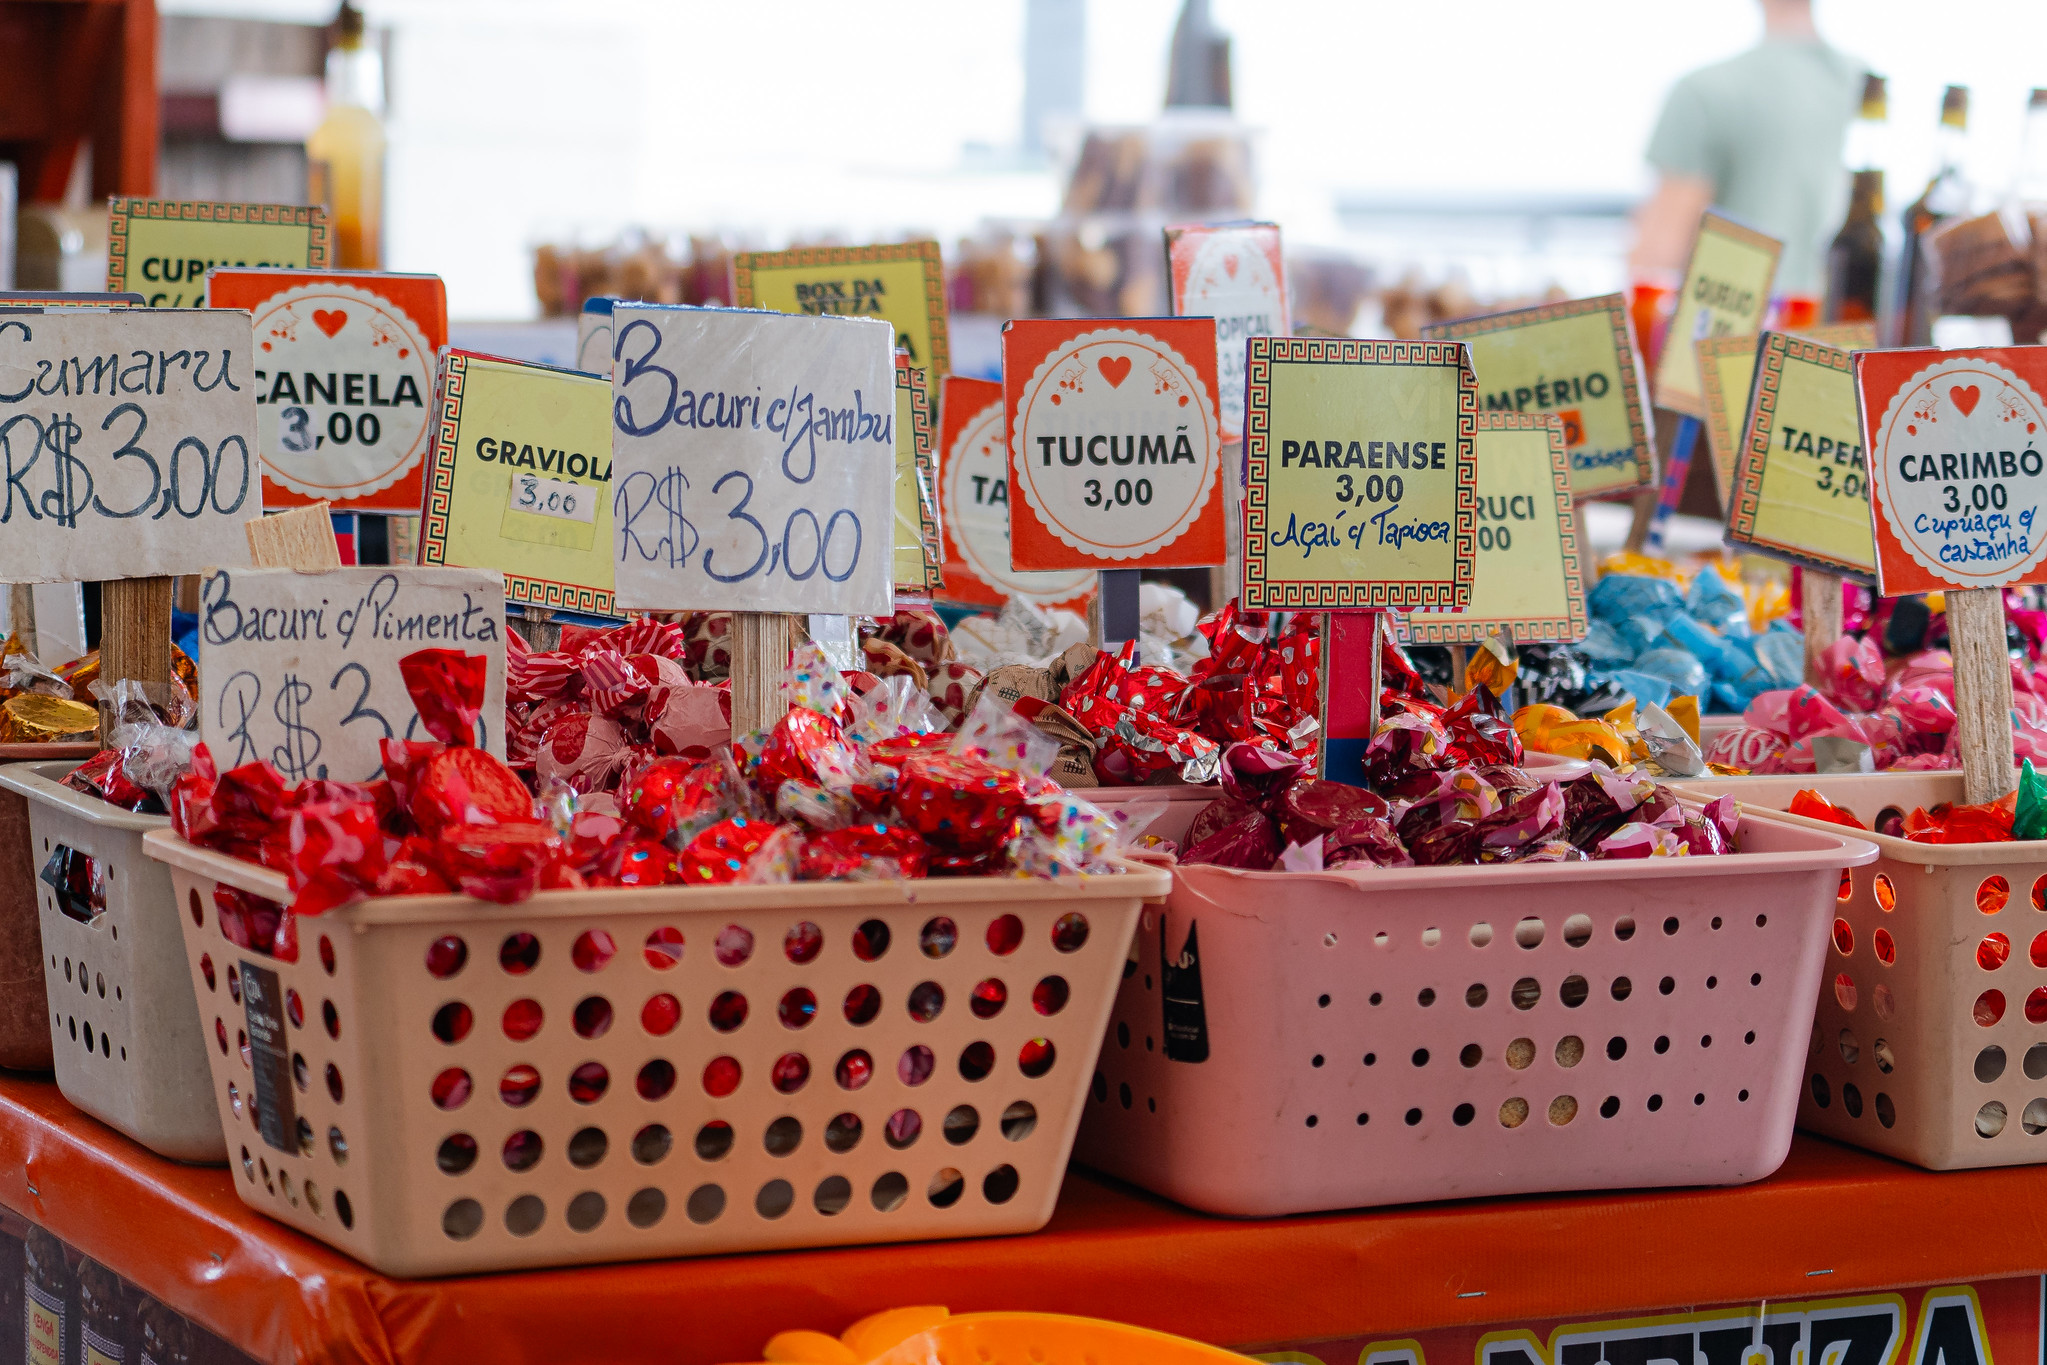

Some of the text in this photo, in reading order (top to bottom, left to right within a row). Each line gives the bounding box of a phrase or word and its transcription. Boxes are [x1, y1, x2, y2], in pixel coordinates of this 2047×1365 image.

[1217, 315, 1271, 340] OPICAL
[0, 321, 241, 403] Cumaru
[614, 319, 762, 437] Bacuri
[281, 406, 381, 453] 3,00
[1036, 425, 1197, 467] TUCUMÃ
[1782, 426, 1864, 471] TAPER
[1281, 439, 1446, 470] PARAENSE
[1899, 440, 2044, 483] CARIMBÓ
[519, 476, 576, 514] 3,00
[1083, 478, 1153, 512] 3,00
[1335, 473, 1404, 507] 3,00
[1476, 495, 1536, 522] RUCI
[1942, 483, 2008, 517] 3,00
[1270, 509, 1347, 559] Açaí
[1370, 503, 1451, 551] Tapioca
[1914, 513, 2012, 541] Cupuaçu
[1939, 532, 2033, 563] castanha
[203, 570, 328, 646] Bacuri
[366, 573, 499, 643] Pimenta
